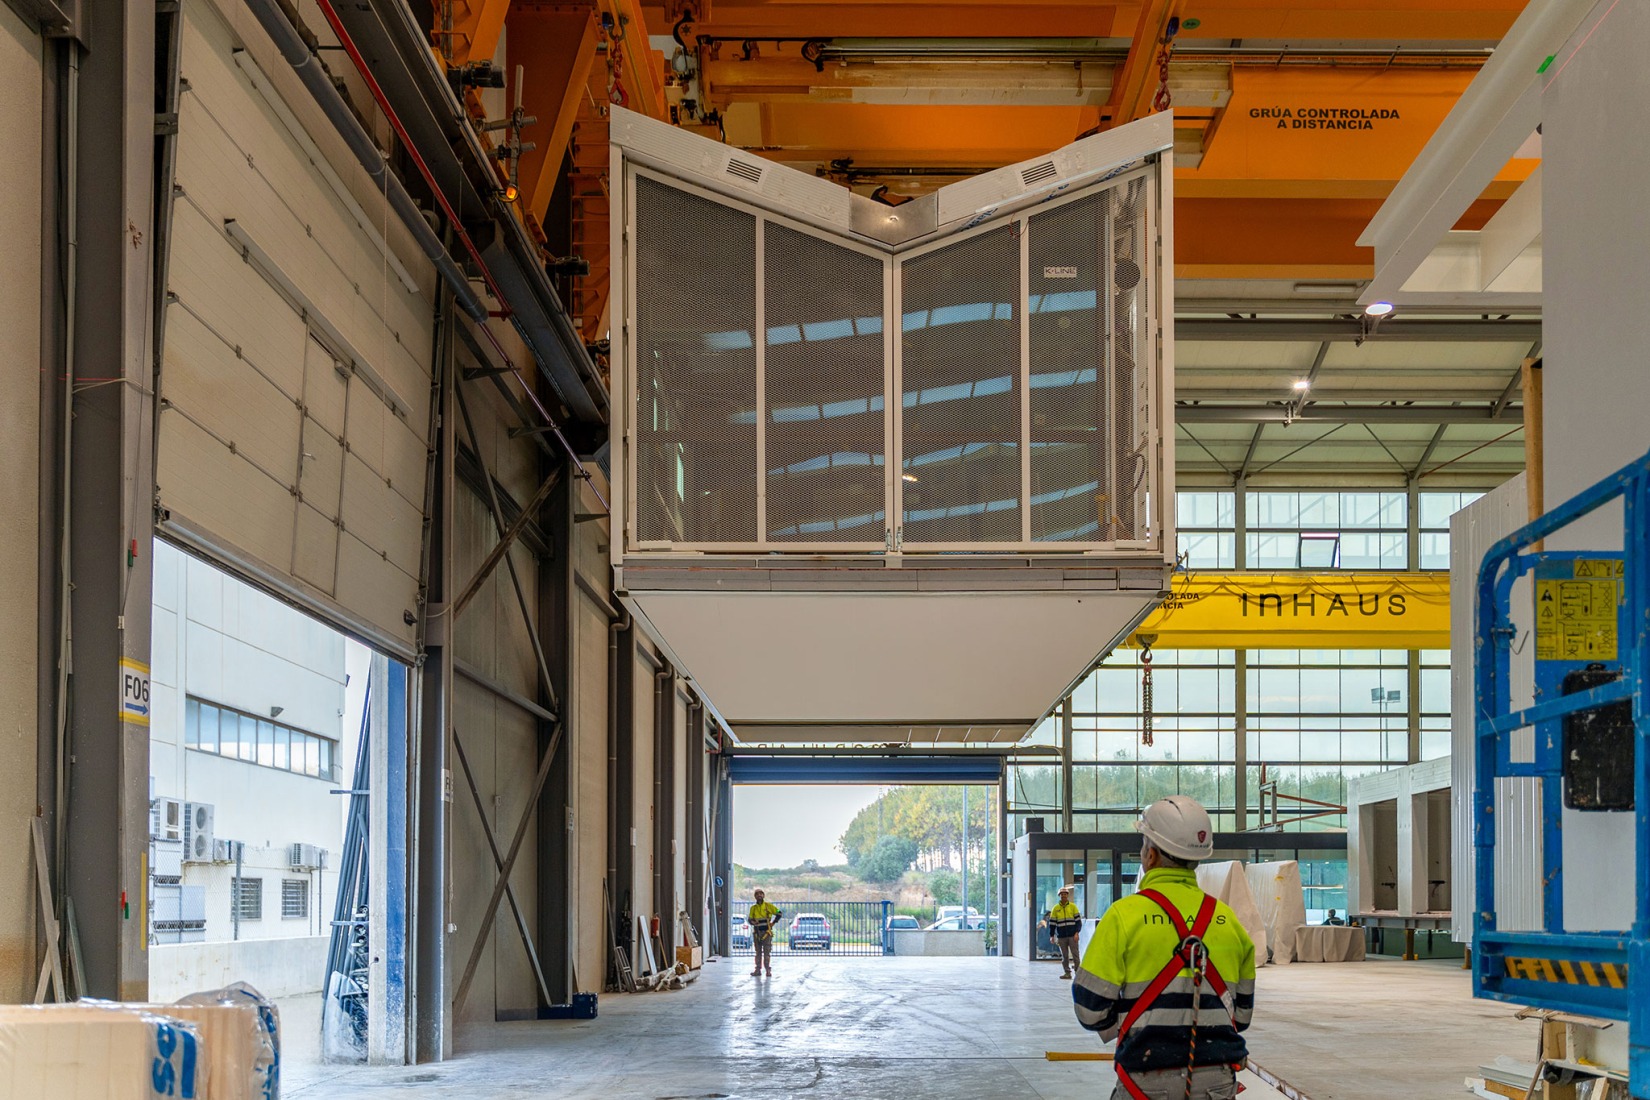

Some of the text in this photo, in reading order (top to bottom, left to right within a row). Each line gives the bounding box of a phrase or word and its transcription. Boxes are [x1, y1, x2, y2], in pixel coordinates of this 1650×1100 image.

[1249, 106, 1400, 119] GRÚA CONTROLADA
[1277, 119, 1373, 130] A DISTANCIA
[125, 674, 149, 702] F06
